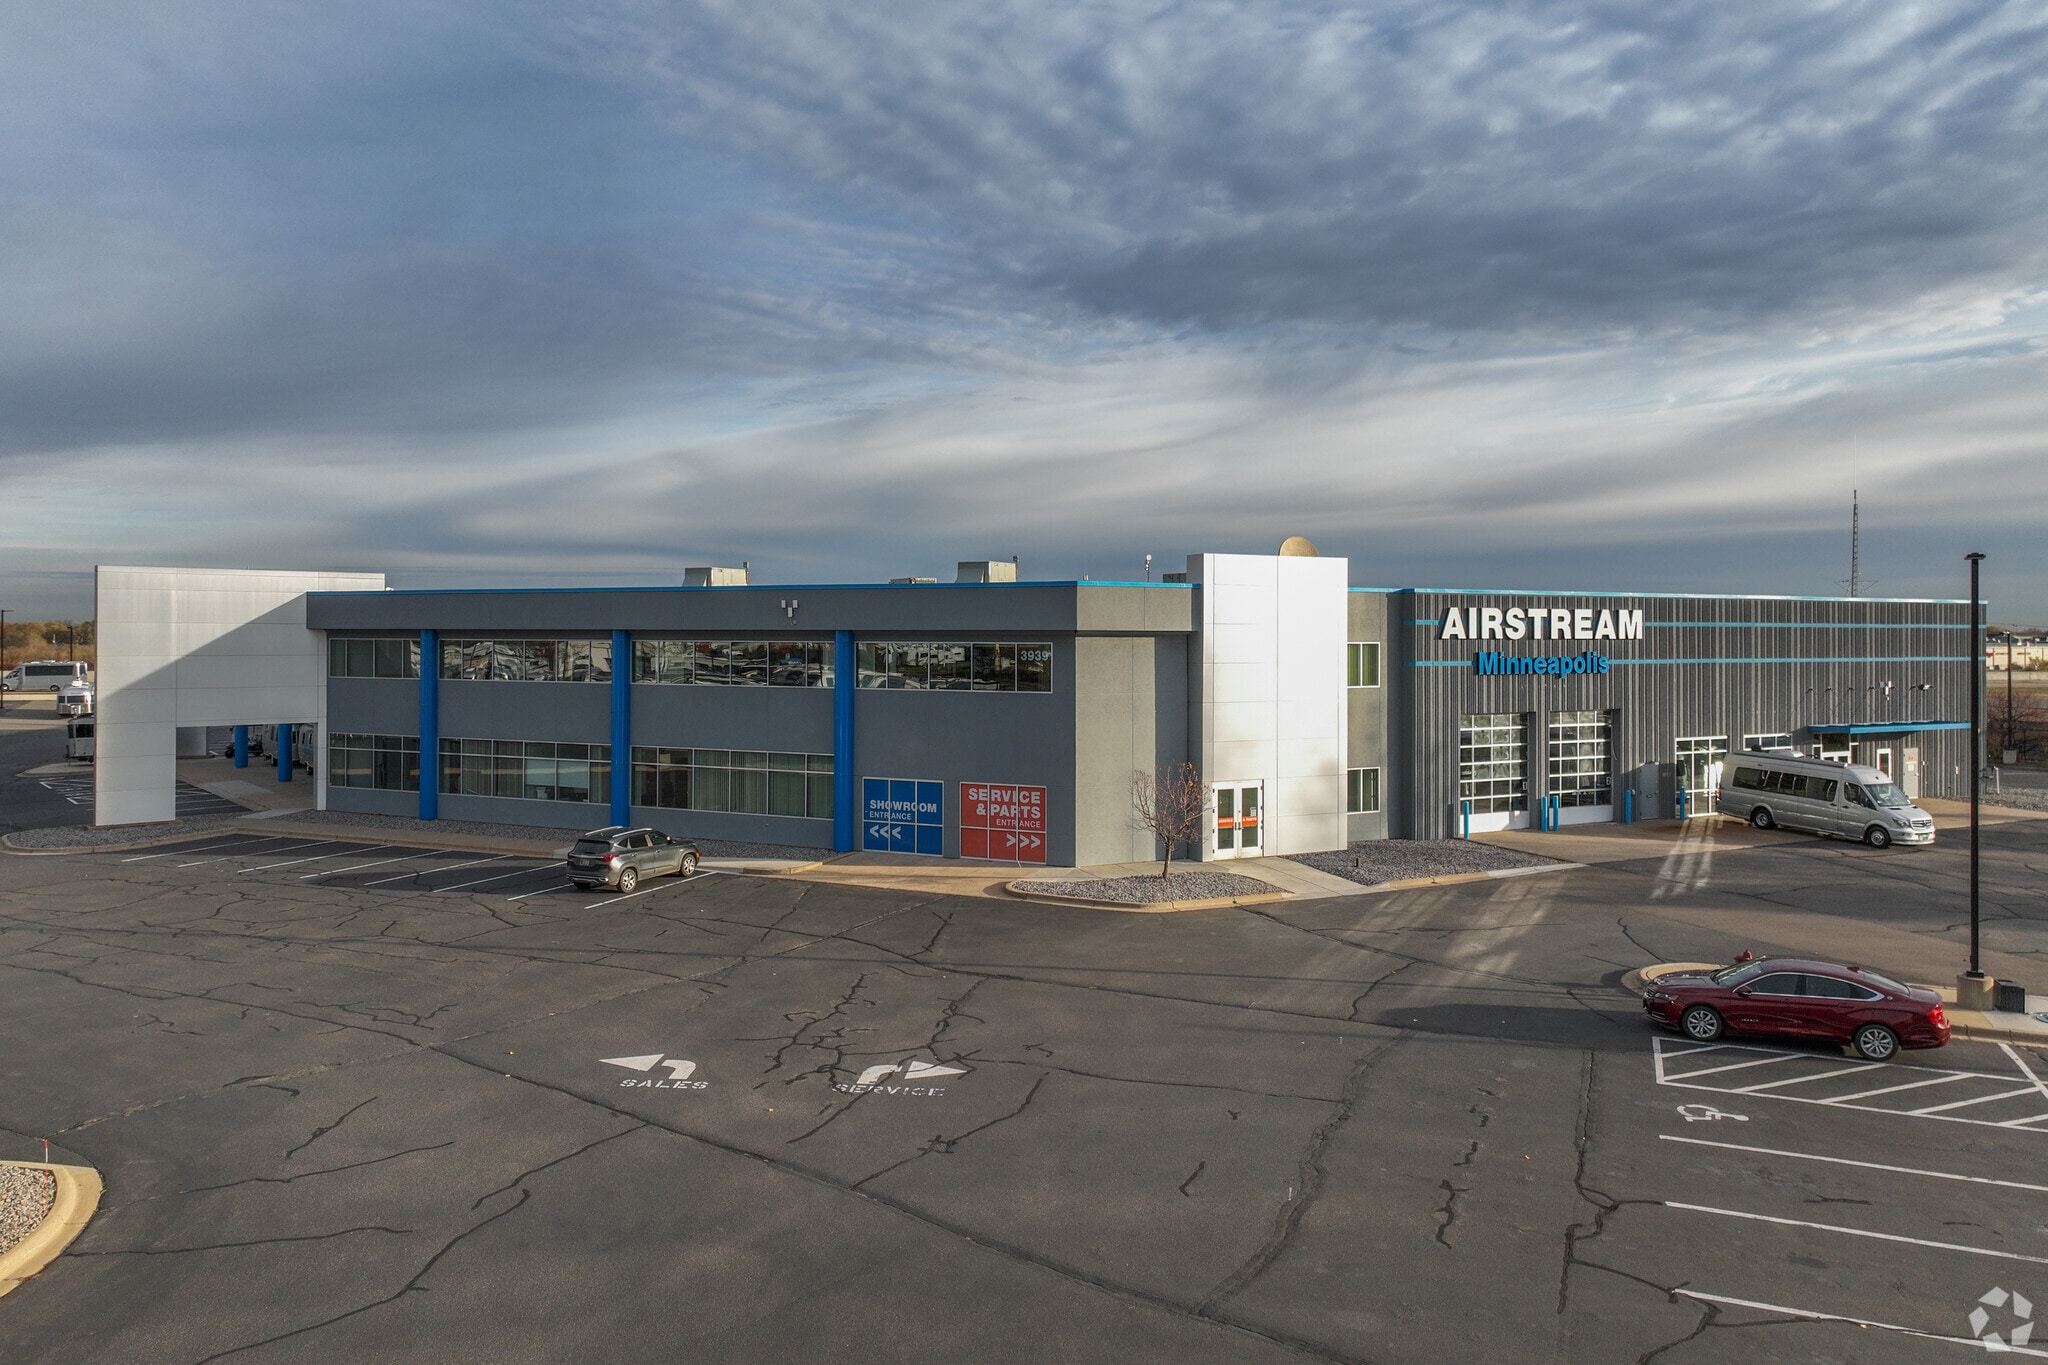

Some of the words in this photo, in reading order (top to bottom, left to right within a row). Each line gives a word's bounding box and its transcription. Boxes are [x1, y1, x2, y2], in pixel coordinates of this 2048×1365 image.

[1441, 607, 1643, 640] AIRSTREAM
[1020, 650, 1049, 661] 3939
[1478, 651, 1610, 679] Minneapolis
[968, 787, 1041, 804] SERVICE
[869, 799, 938, 813] SHOWROOM
[976, 803, 987, 816] &
[990, 804, 1041, 819] PARTS
[869, 811, 912, 820] ENTRANCE
[996, 818, 1041, 828] ENTRANCE
[619, 1079, 709, 1090] SALES
[831, 1083, 946, 1097] SERVICE
